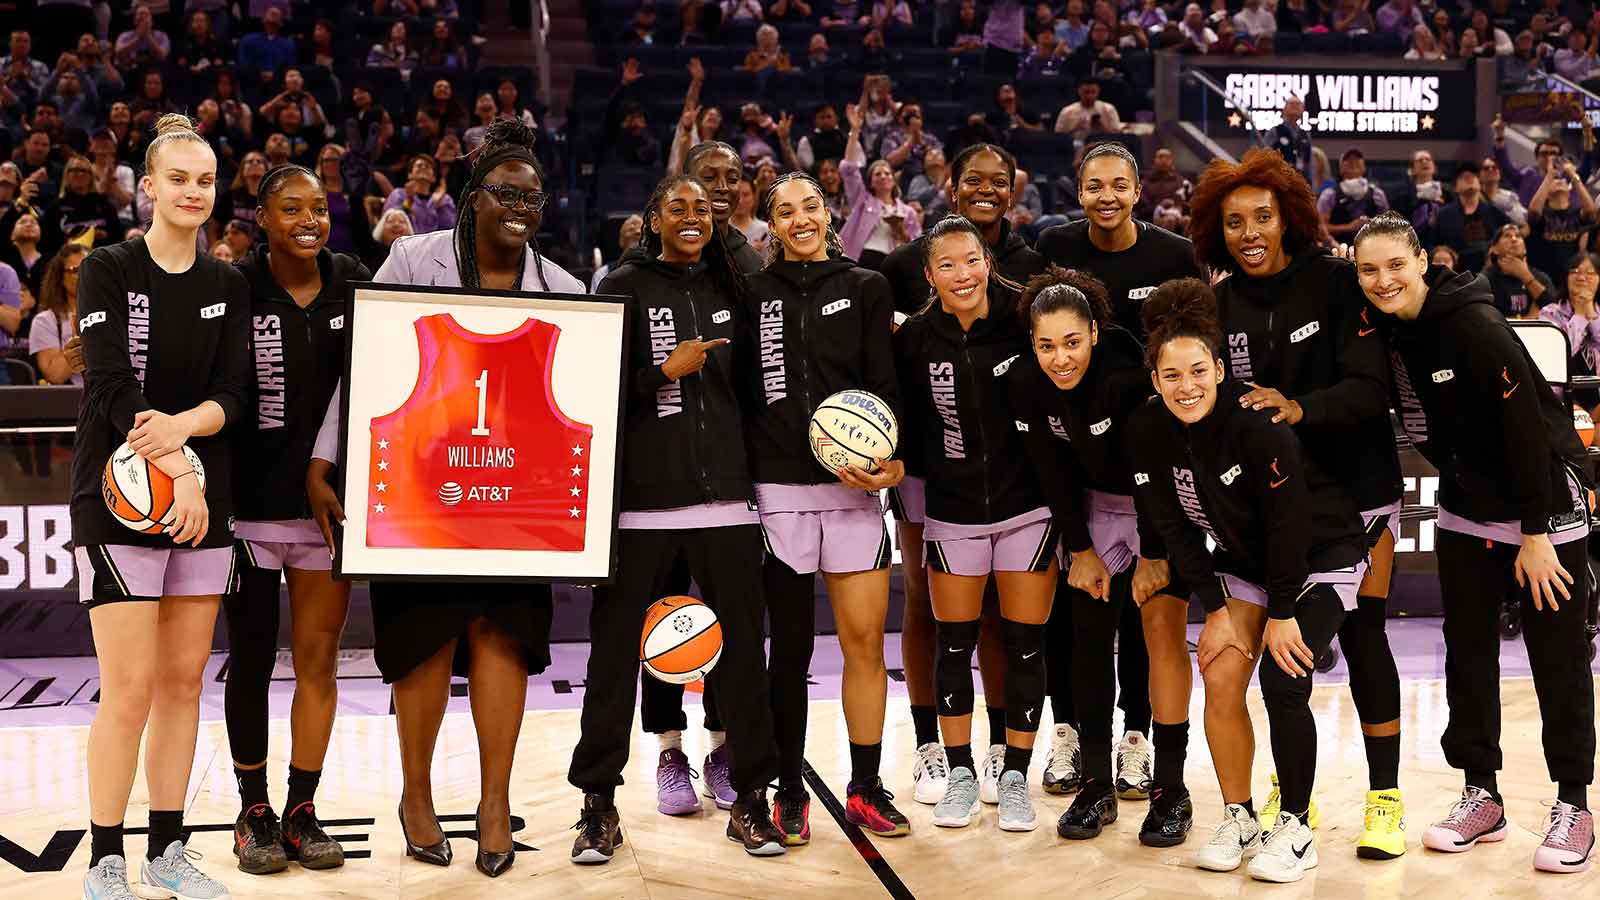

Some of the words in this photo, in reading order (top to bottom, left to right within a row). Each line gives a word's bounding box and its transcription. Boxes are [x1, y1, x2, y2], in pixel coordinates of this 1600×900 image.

[1224, 73, 1309, 109] GABBY
[1315, 75, 1439, 111] WILLIAMS
[252, 314, 286, 430] VALKYRIES
[648, 307, 683, 418] VALYRIES
[760, 299, 788, 405] VALKYRIES
[471, 369, 490, 436] 1
[841, 394, 892, 433] Wilson
[928, 362, 966, 459] VALKYRIES
[447, 446, 516, 468] WILLIAMS
[467, 486, 512, 501] AT&T
